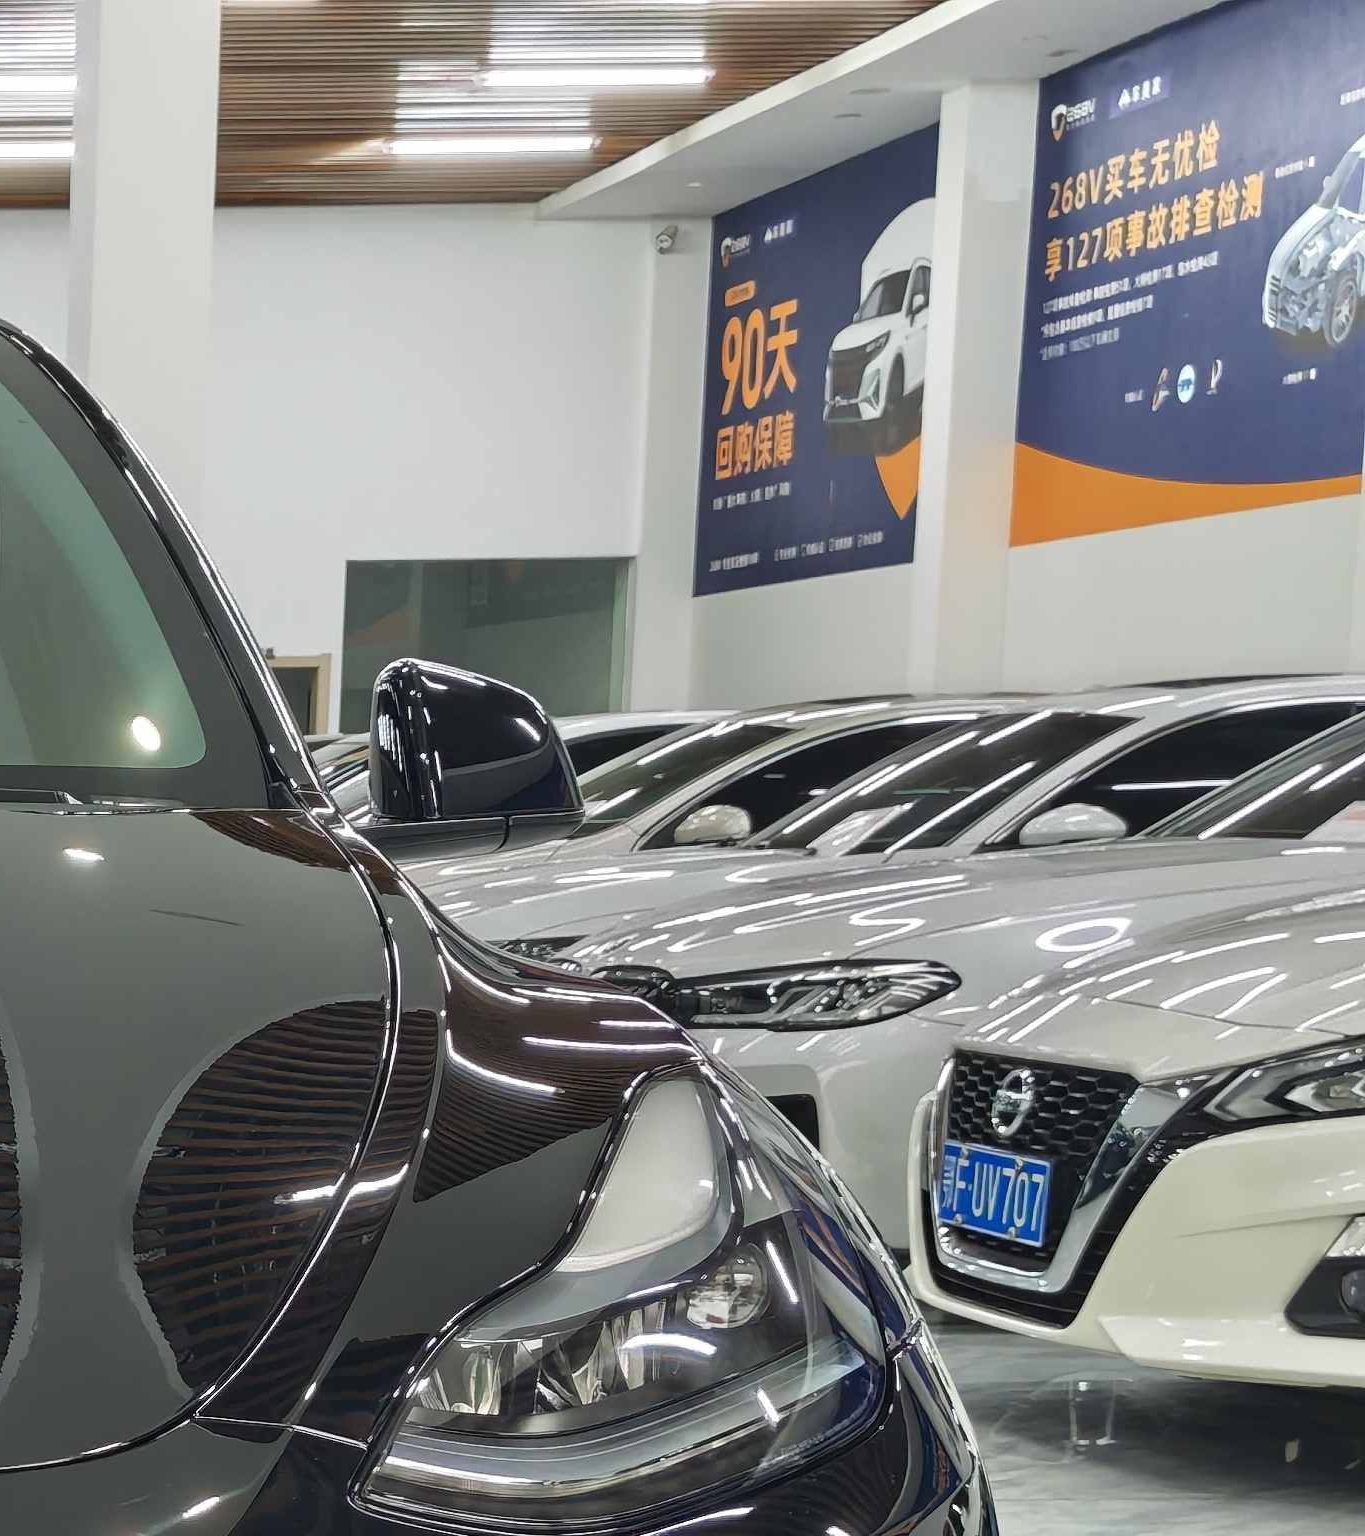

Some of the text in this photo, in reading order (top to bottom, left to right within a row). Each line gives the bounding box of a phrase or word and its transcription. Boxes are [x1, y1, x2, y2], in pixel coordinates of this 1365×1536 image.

[1044, 170, 1264, 282] 享127项事故排查检测
[721, 299, 798, 416] 90天
[715, 409, 795, 480] 回购保障
